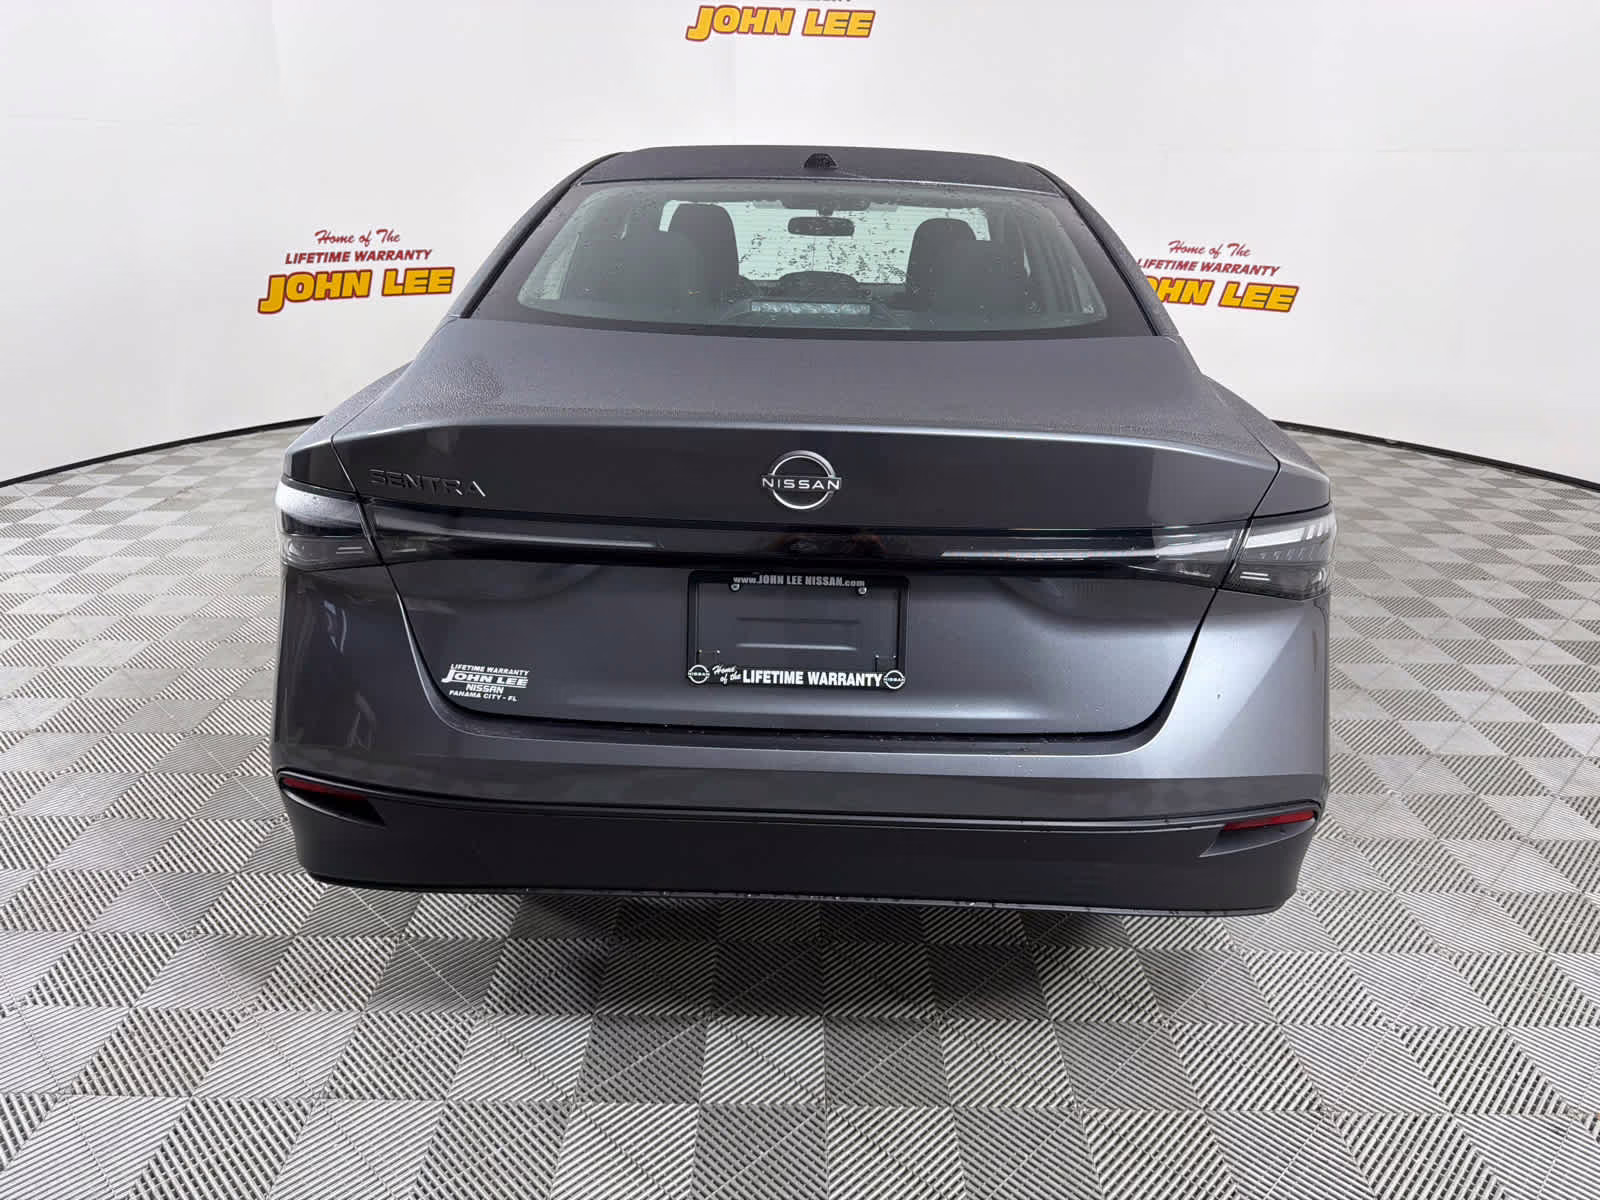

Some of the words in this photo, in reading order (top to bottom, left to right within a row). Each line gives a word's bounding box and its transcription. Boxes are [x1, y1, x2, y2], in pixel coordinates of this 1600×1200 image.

[685, 5, 796, 42] JOHN
[802, 8, 876, 38] LEE
[314, 229, 355, 245] Home
[358, 231, 372, 247] of
[375, 228, 400, 244] The
[285, 251, 351, 265] LIFETIME
[354, 249, 432, 262] WARRANTY
[1168, 240, 1205, 255] Home
[1209, 244, 1223, 259] of
[1227, 243, 1251, 257] The
[1137, 258, 1199, 272] LIFETIME
[1200, 261, 1280, 277] WARRANTY
[257, 269, 373, 314] JOHN
[381, 267, 455, 297] LEE
[1218, 281, 1299, 312] LEE
[368, 467, 487, 497] SENTRA
[762, 477, 840, 490] NISSAN
[786, 575, 802, 585] LEE
[441, 669, 493, 683] JOHN
[496, 676, 528, 686] LEE
[450, 664, 485, 672] LIFETIME
[486, 667, 530, 676] WARRANTY
[712, 665, 736, 675] Home
[719, 674, 729, 685] of
[729, 672, 742, 681] the
[742, 669, 804, 685] LIFETIME
[807, 671, 883, 687] WARRANTY
[449, 690, 481, 698] PANAMA
[483, 692, 501, 700] CITY
[465, 684, 504, 694] NISSAN
